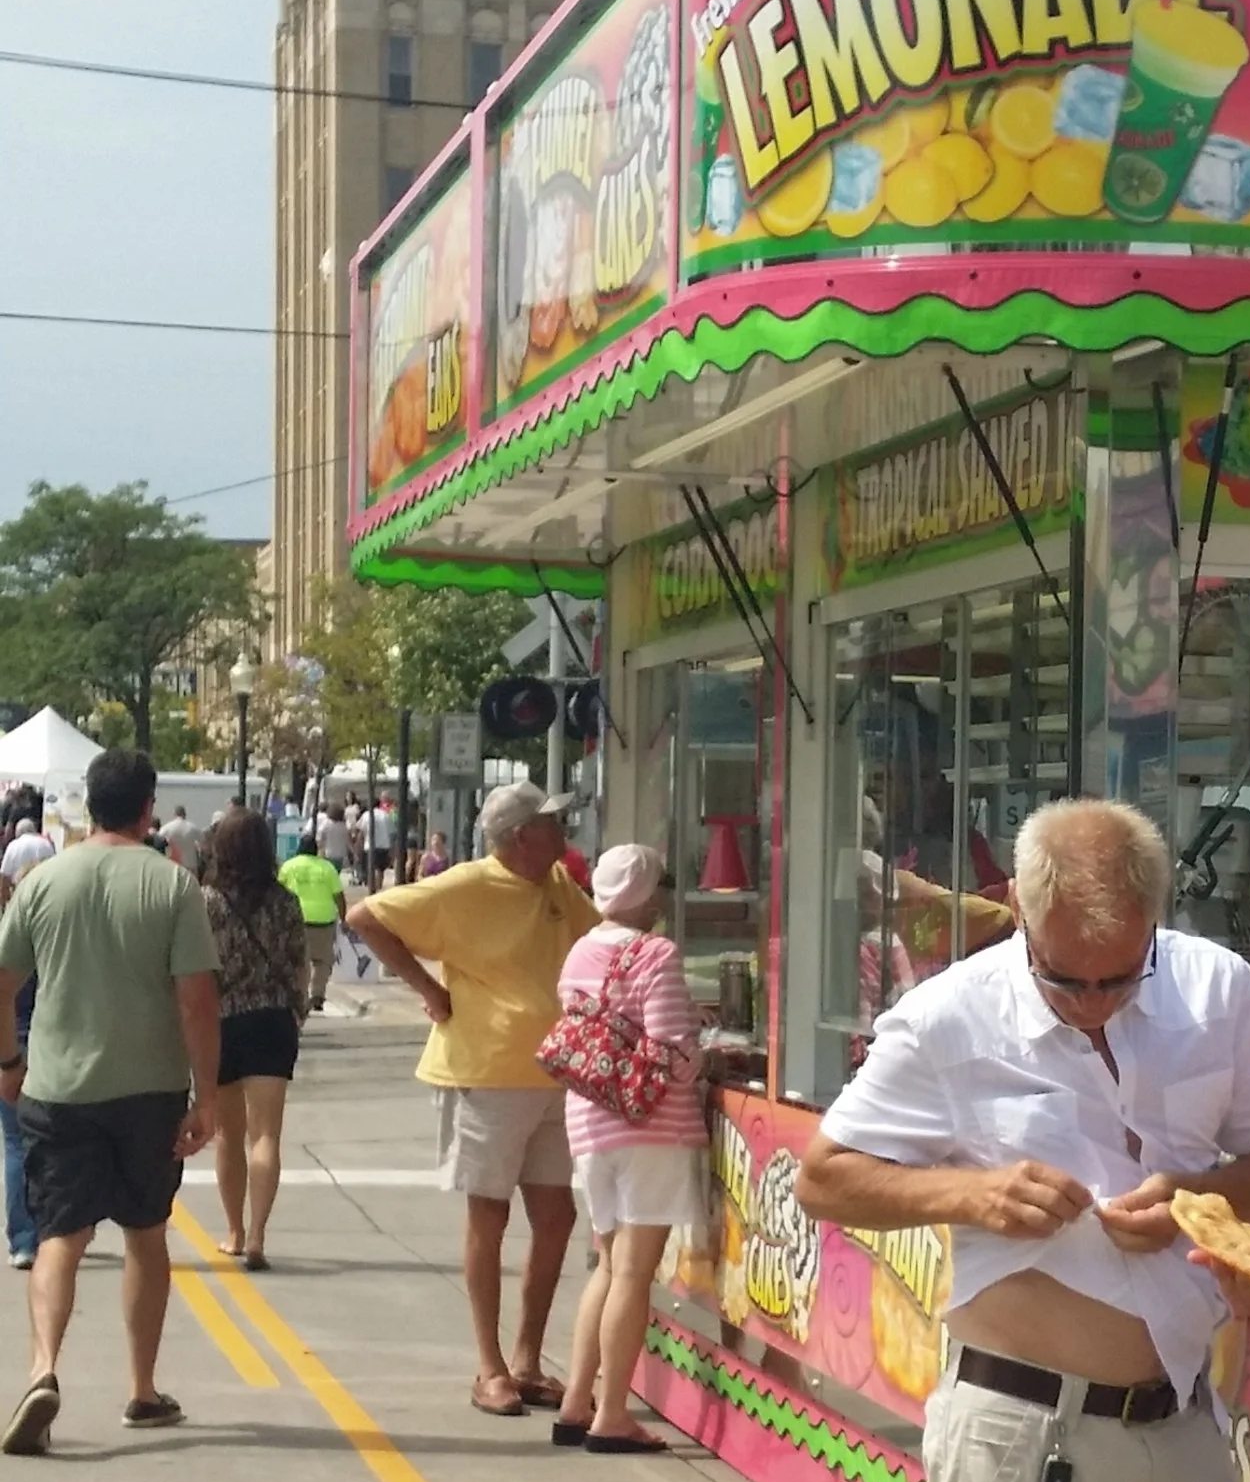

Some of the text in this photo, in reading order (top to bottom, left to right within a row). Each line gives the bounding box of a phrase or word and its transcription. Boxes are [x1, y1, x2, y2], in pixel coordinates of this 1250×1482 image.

[594, 134, 655, 292] CAKES
[427, 318, 461, 432] EARS
[857, 435, 951, 559] TROPICAL
[957, 395, 1049, 531] SHAVED
[746, 1232, 792, 1317] CAKES
